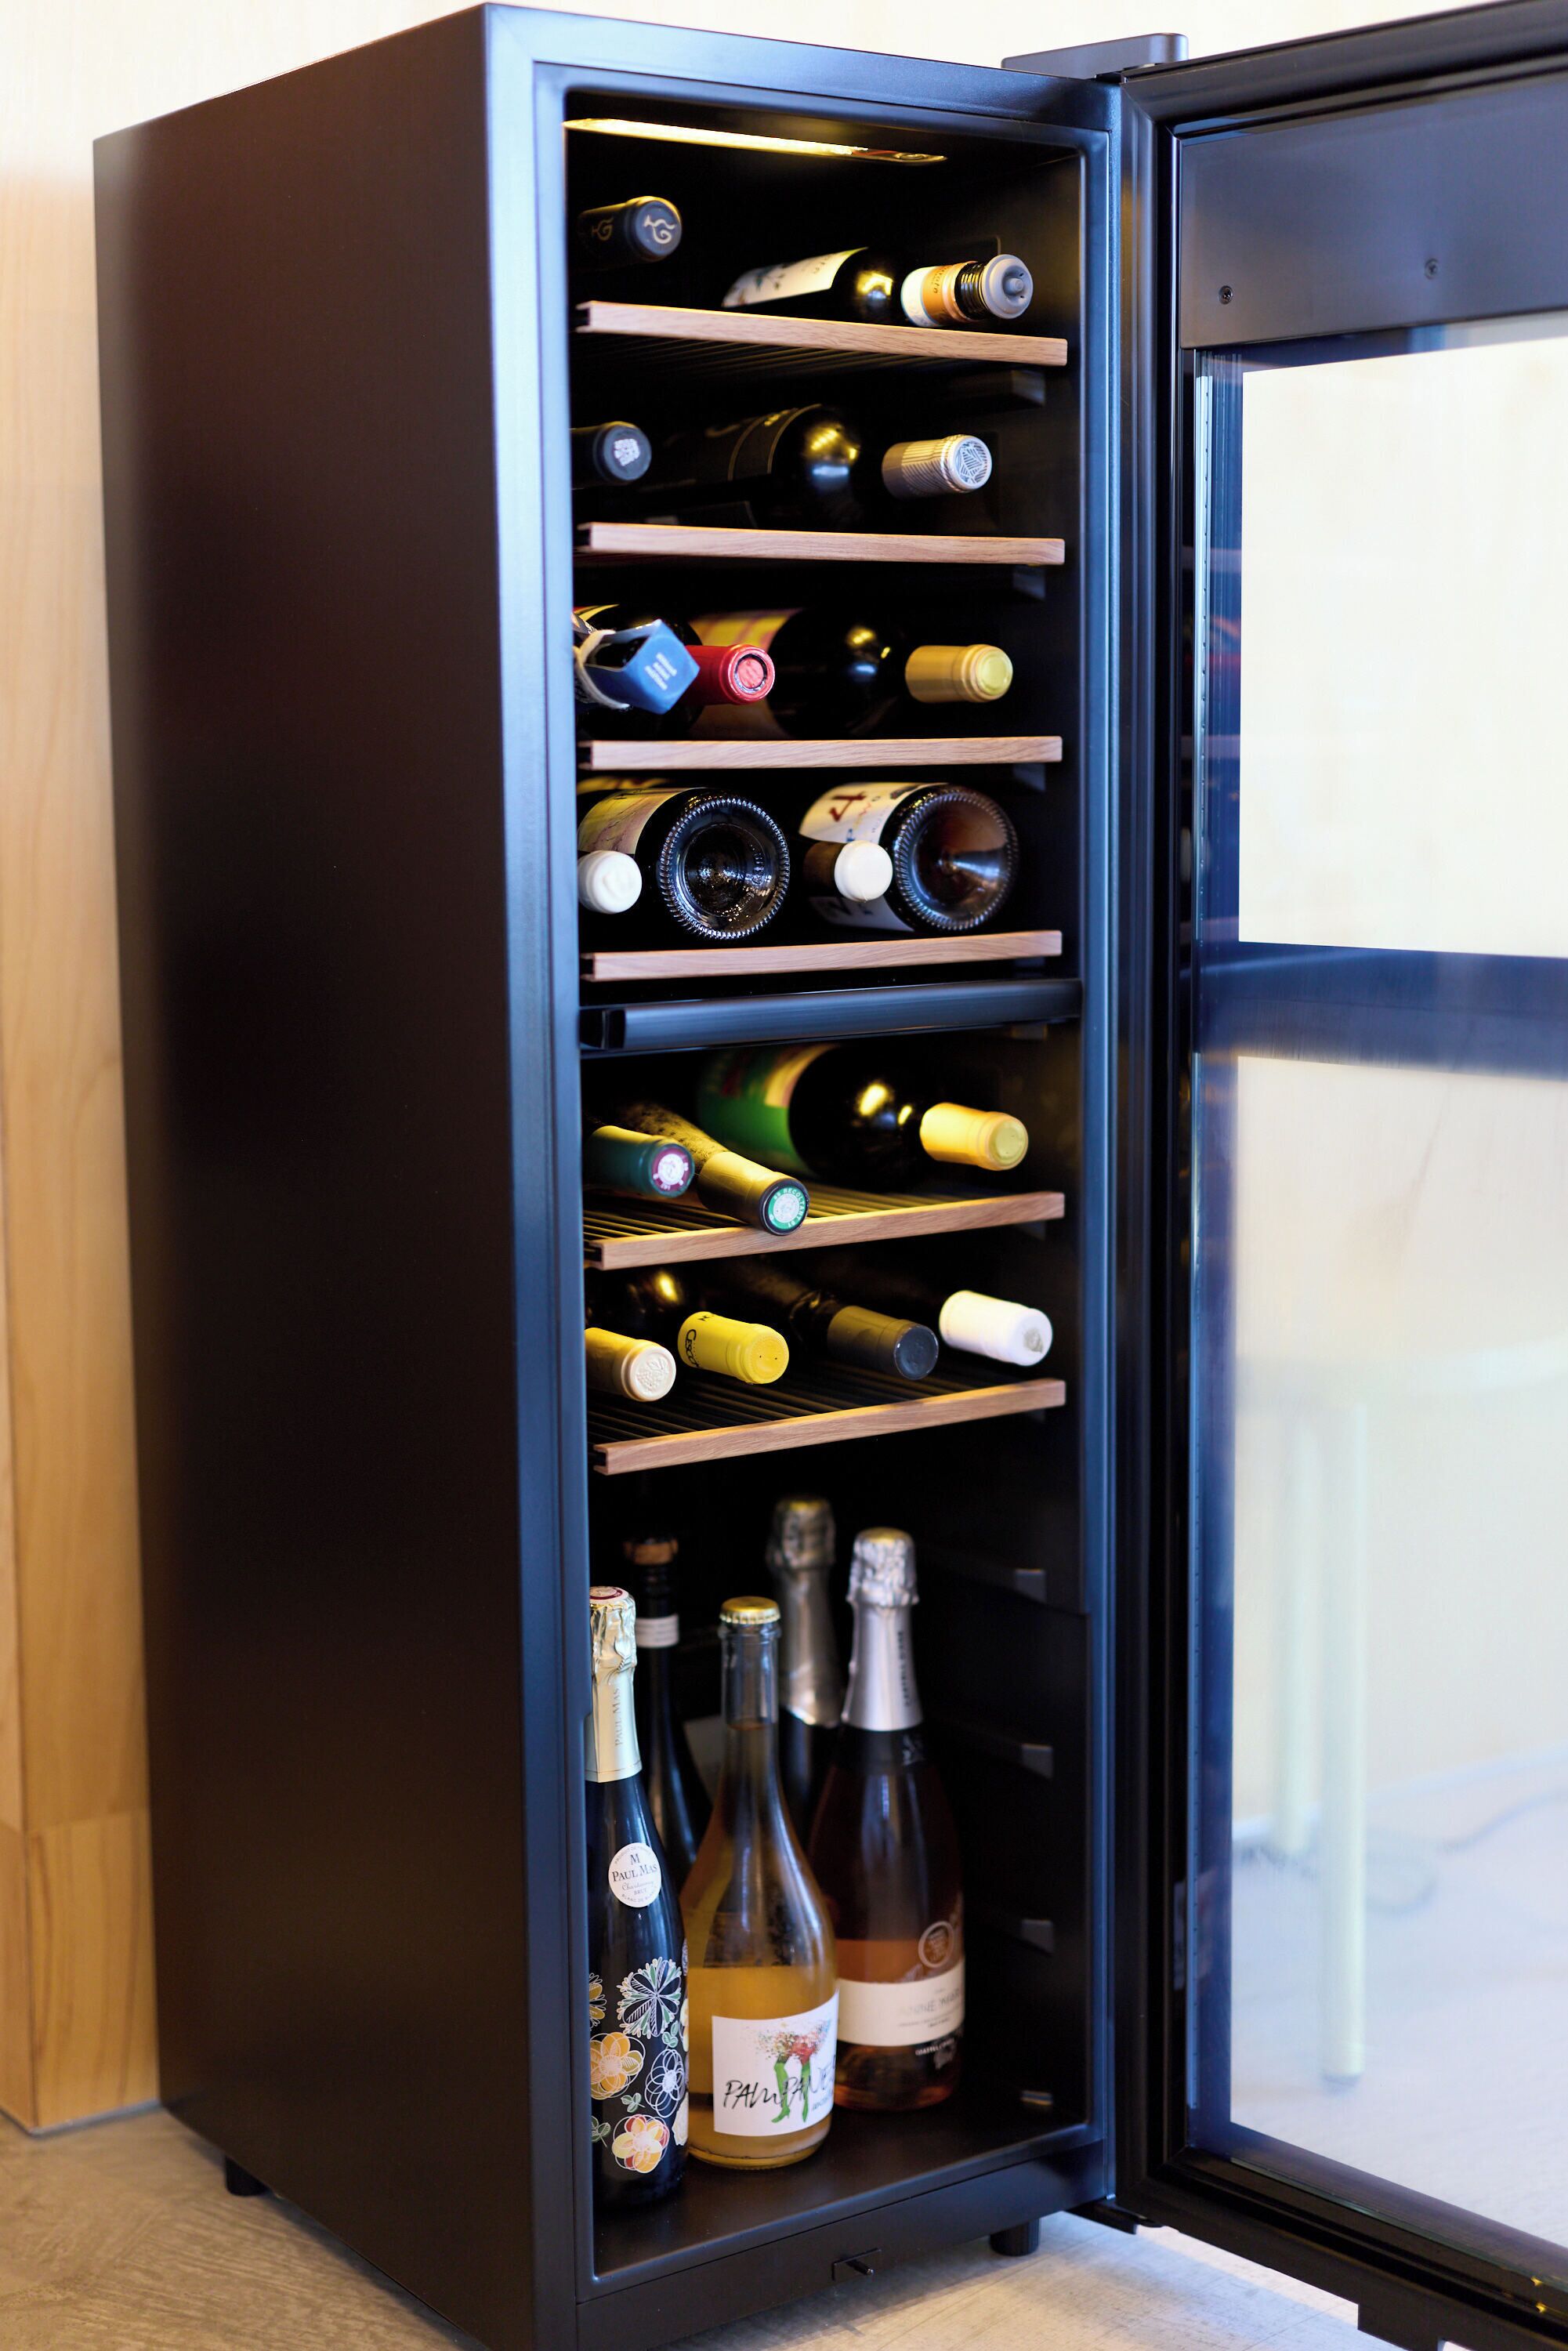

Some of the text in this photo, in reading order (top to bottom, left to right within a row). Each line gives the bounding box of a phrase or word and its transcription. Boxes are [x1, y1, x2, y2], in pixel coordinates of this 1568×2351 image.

[612, 1687, 624, 1746] PAUL MAS
[630, 1853, 640, 1865] M
[612, 1864, 657, 1882] PAUL MAS
